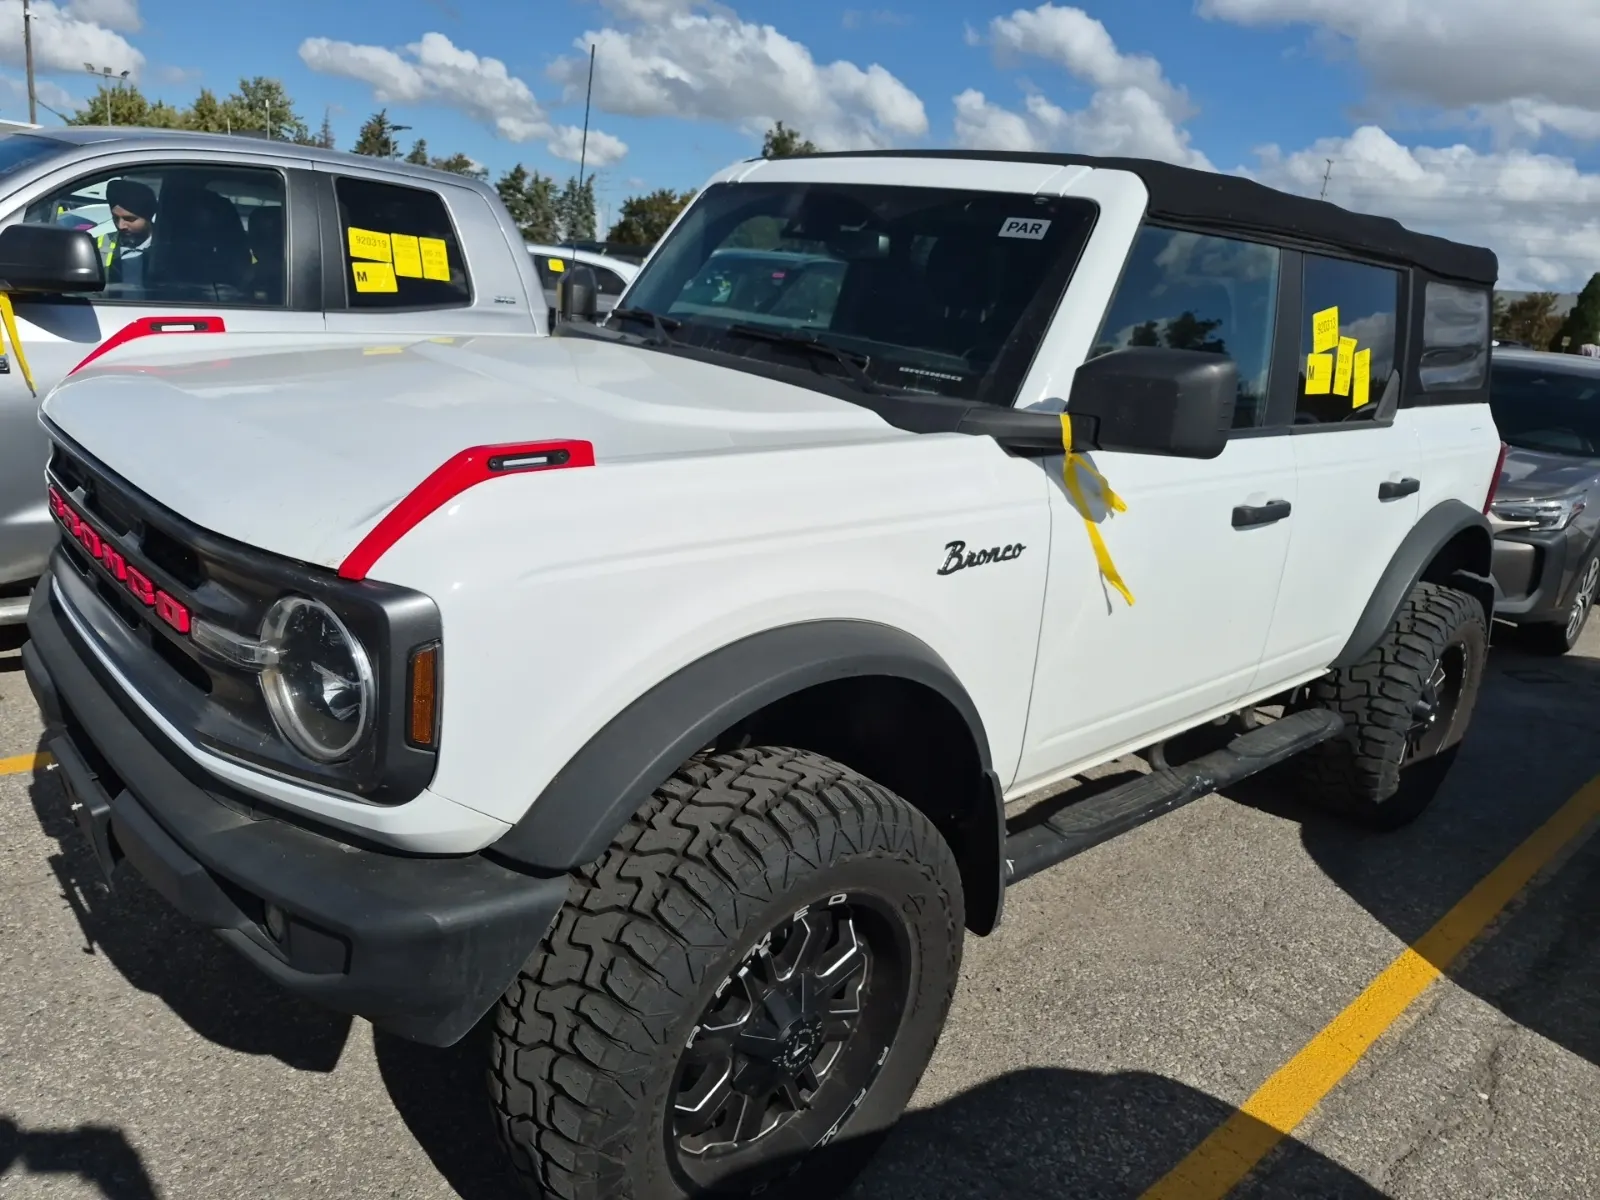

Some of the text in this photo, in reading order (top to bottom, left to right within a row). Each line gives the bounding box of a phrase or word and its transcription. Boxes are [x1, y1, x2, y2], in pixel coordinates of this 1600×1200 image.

[1006, 222, 1043, 234] PAR
[355, 235, 388, 249] 920319
[356, 271, 368, 283] M
[1308, 365, 1315, 380] M
[936, 540, 1027, 576] Bronco
